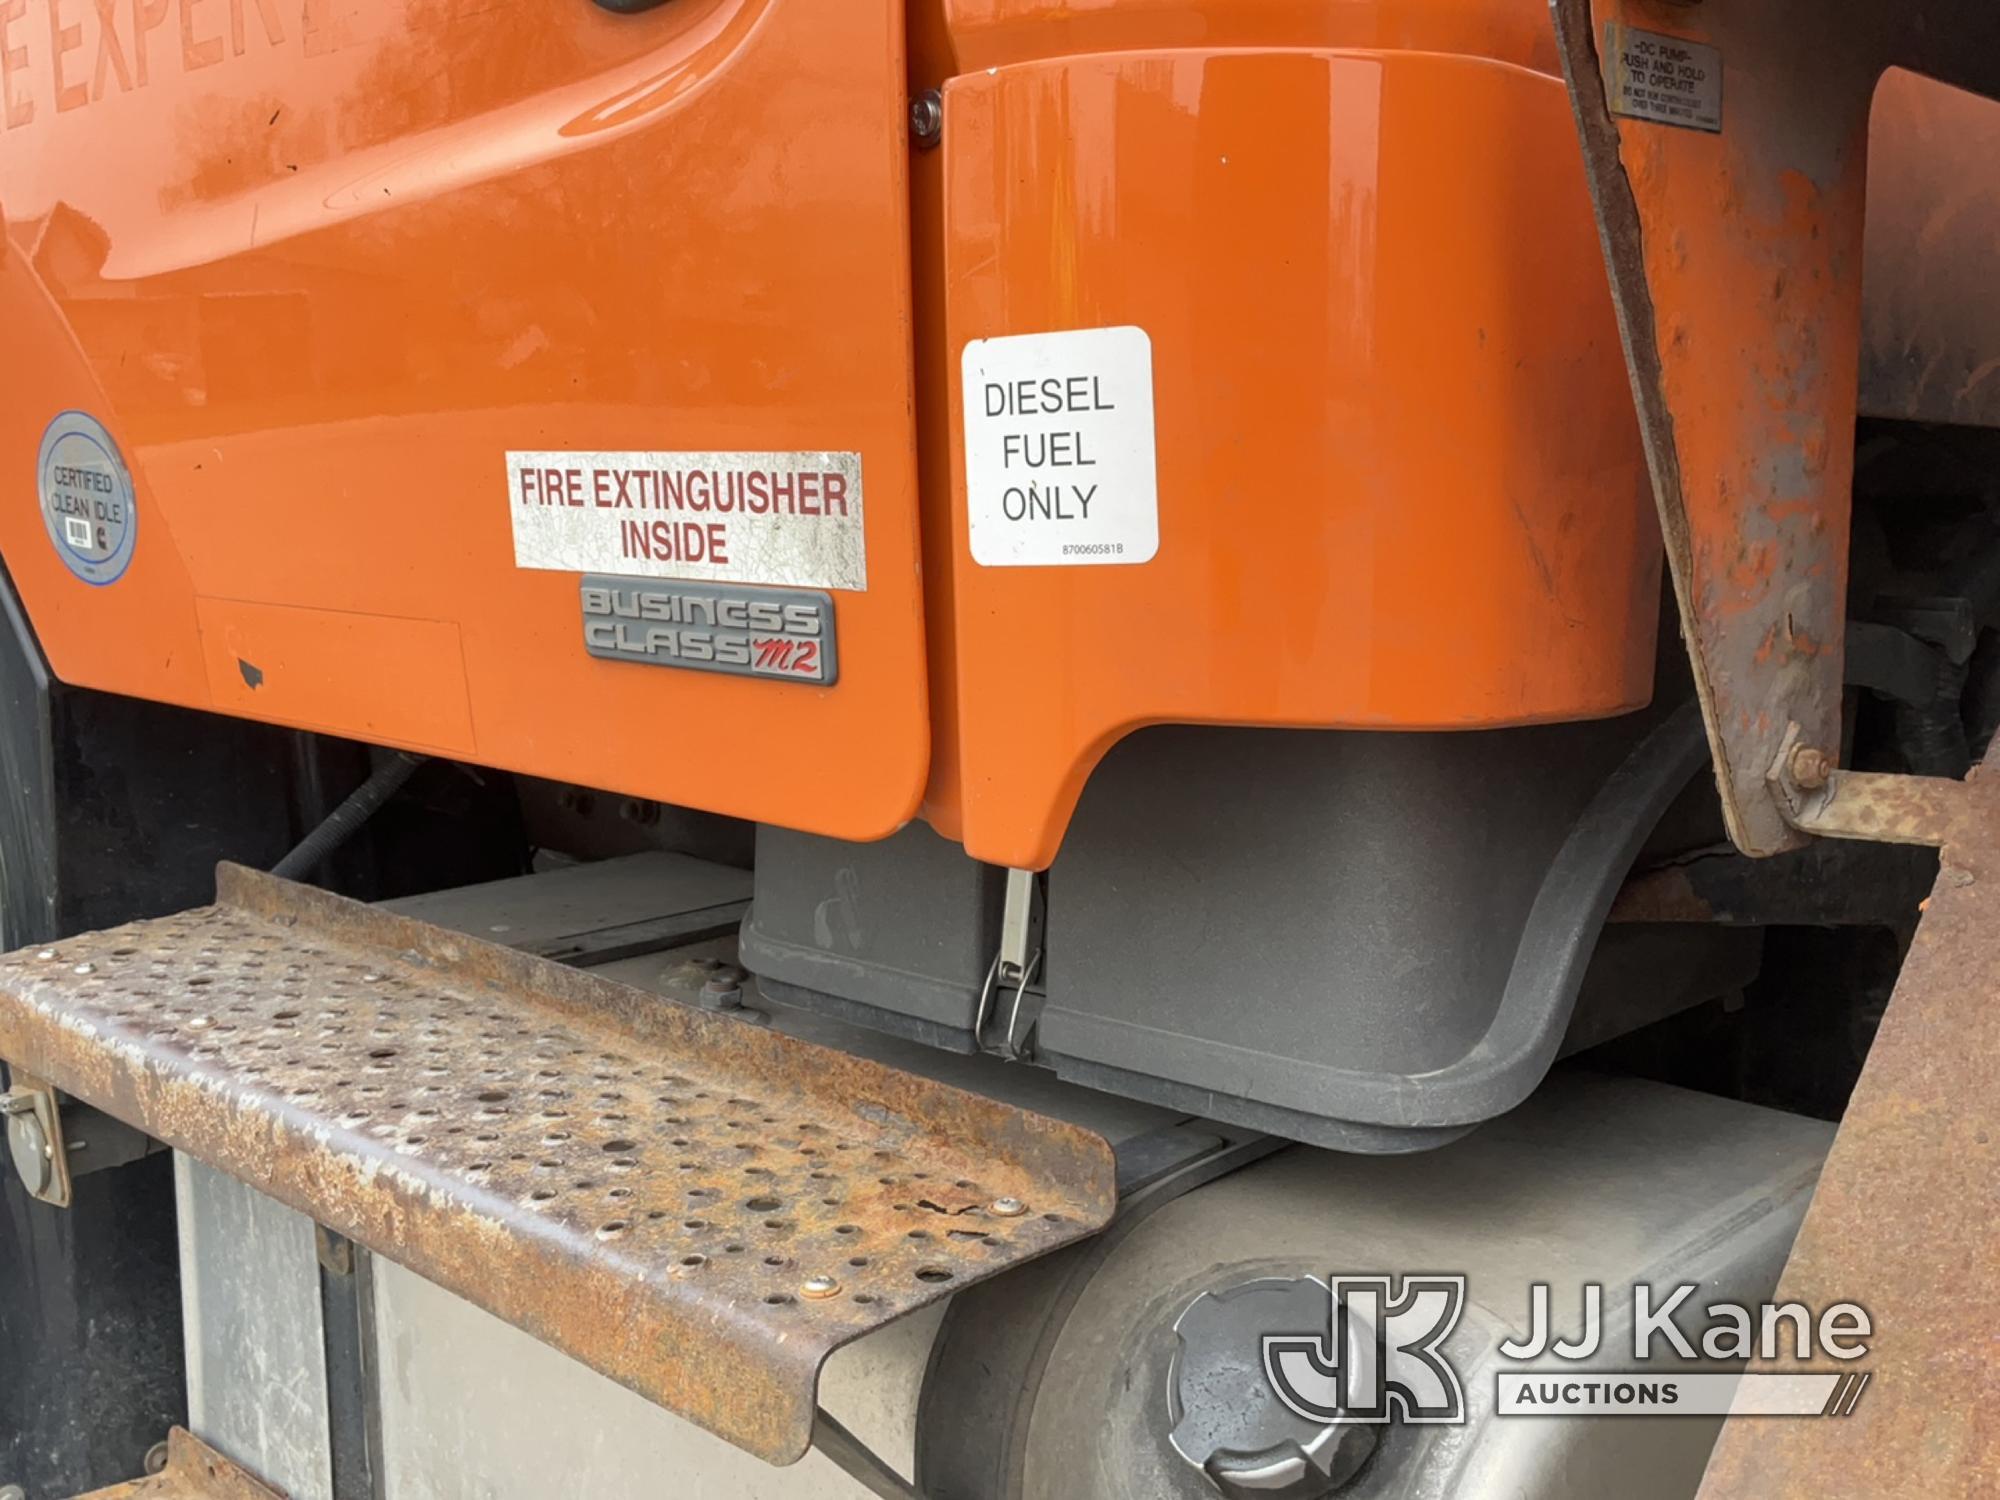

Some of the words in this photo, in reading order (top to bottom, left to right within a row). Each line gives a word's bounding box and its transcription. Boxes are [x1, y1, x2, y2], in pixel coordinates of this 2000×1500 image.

[1630, 69, 1645, 84] TO
[1652, 60, 1674, 75] AND
[1678, 66, 1705, 82] HOLD
[985, 376, 1115, 417] DIESEL
[1003, 431, 1096, 468] FUEL
[54, 465, 113, 494] CERTIFIED
[520, 467, 585, 507] FIRE
[593, 469, 849, 516] EXTINGUISHER
[52, 493, 90, 519] CLEAN
[94, 501, 122, 524] IDLE
[1002, 484, 1098, 521] ONLY
[620, 519, 729, 564] INSIDE
[1062, 542, 1124, 556] 870060581B
[581, 587, 820, 635] BUSINESS
[584, 622, 750, 664] CLASS
